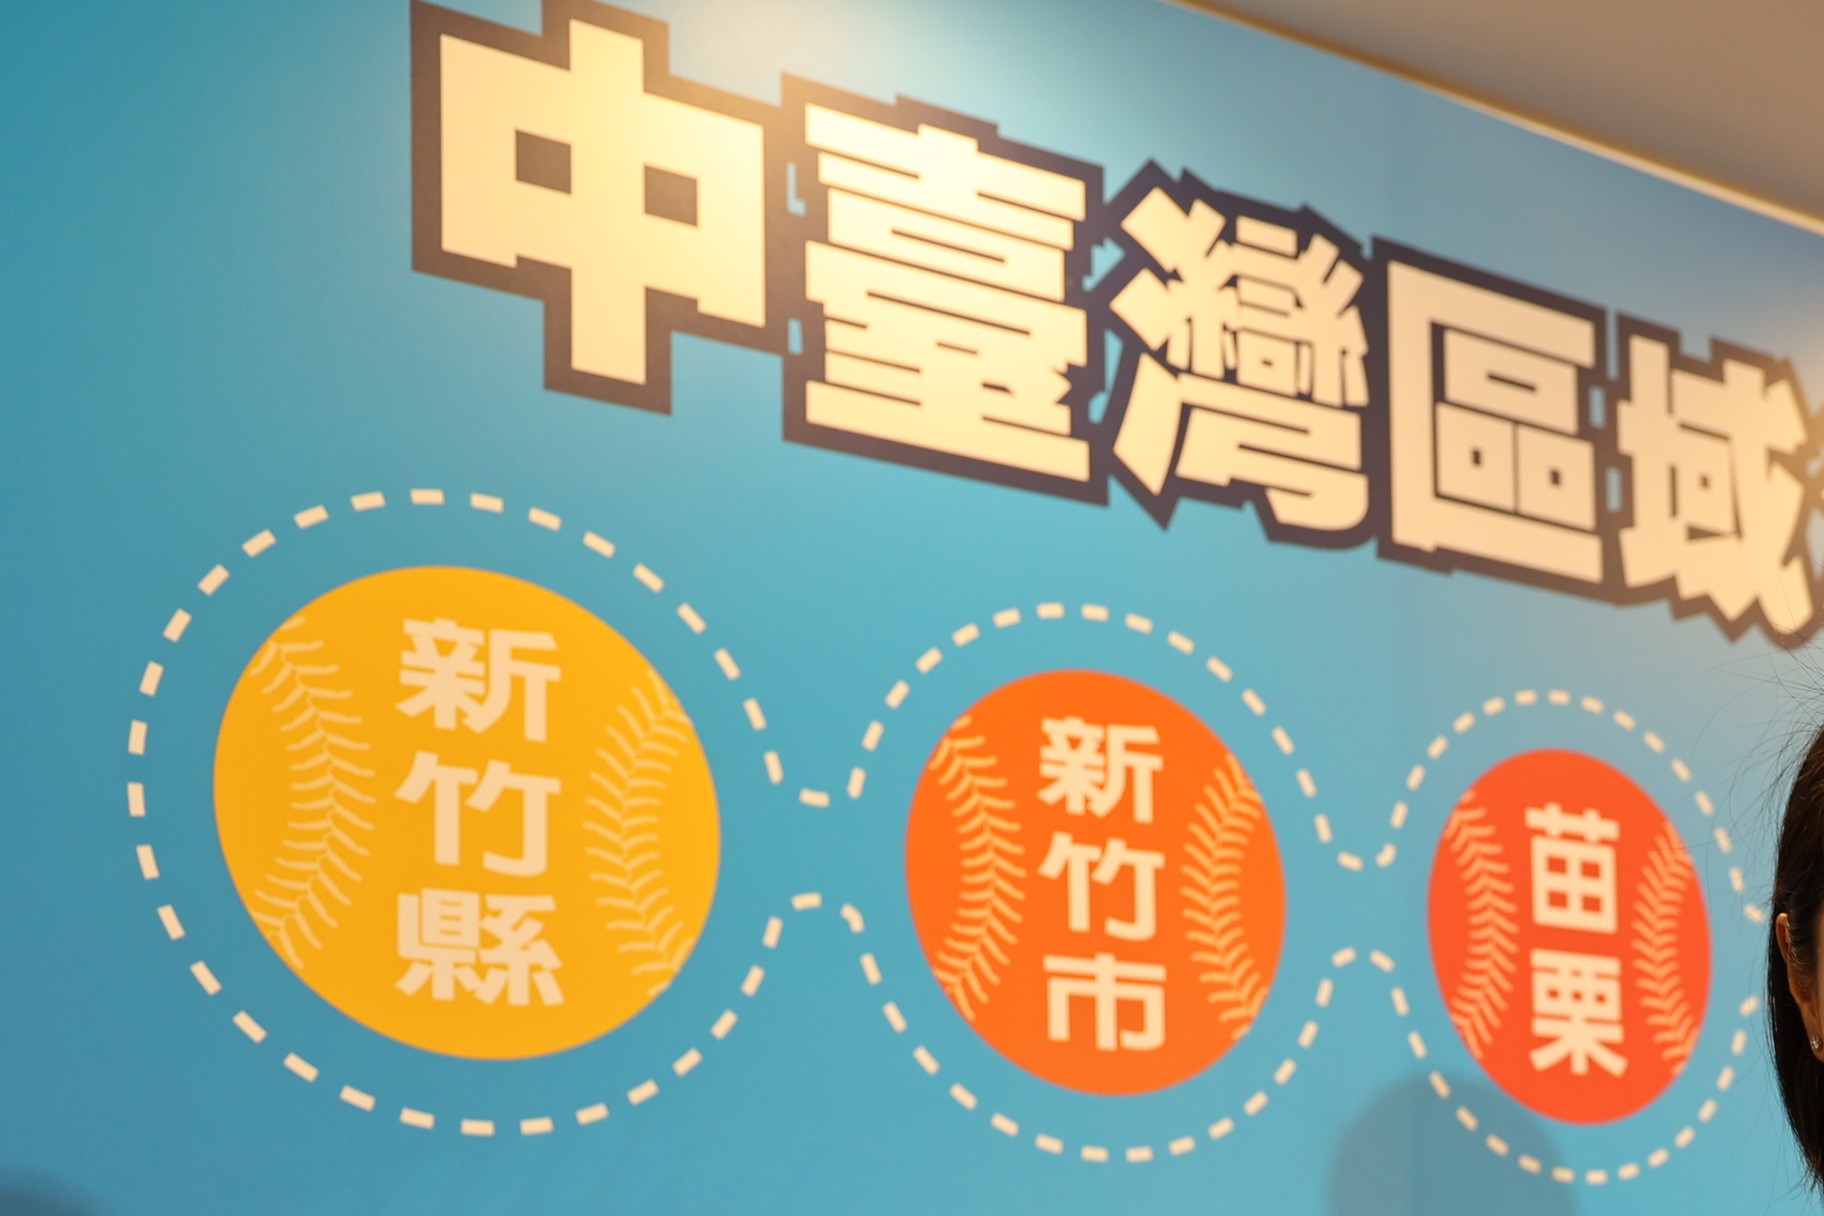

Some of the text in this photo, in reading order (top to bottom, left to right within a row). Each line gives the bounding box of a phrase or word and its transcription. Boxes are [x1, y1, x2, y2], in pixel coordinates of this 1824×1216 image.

[394, 617, 564, 1007] 新竹縣
[1037, 716, 1167, 1051] 新竹市
[1524, 802, 1628, 1078] 苗栗
